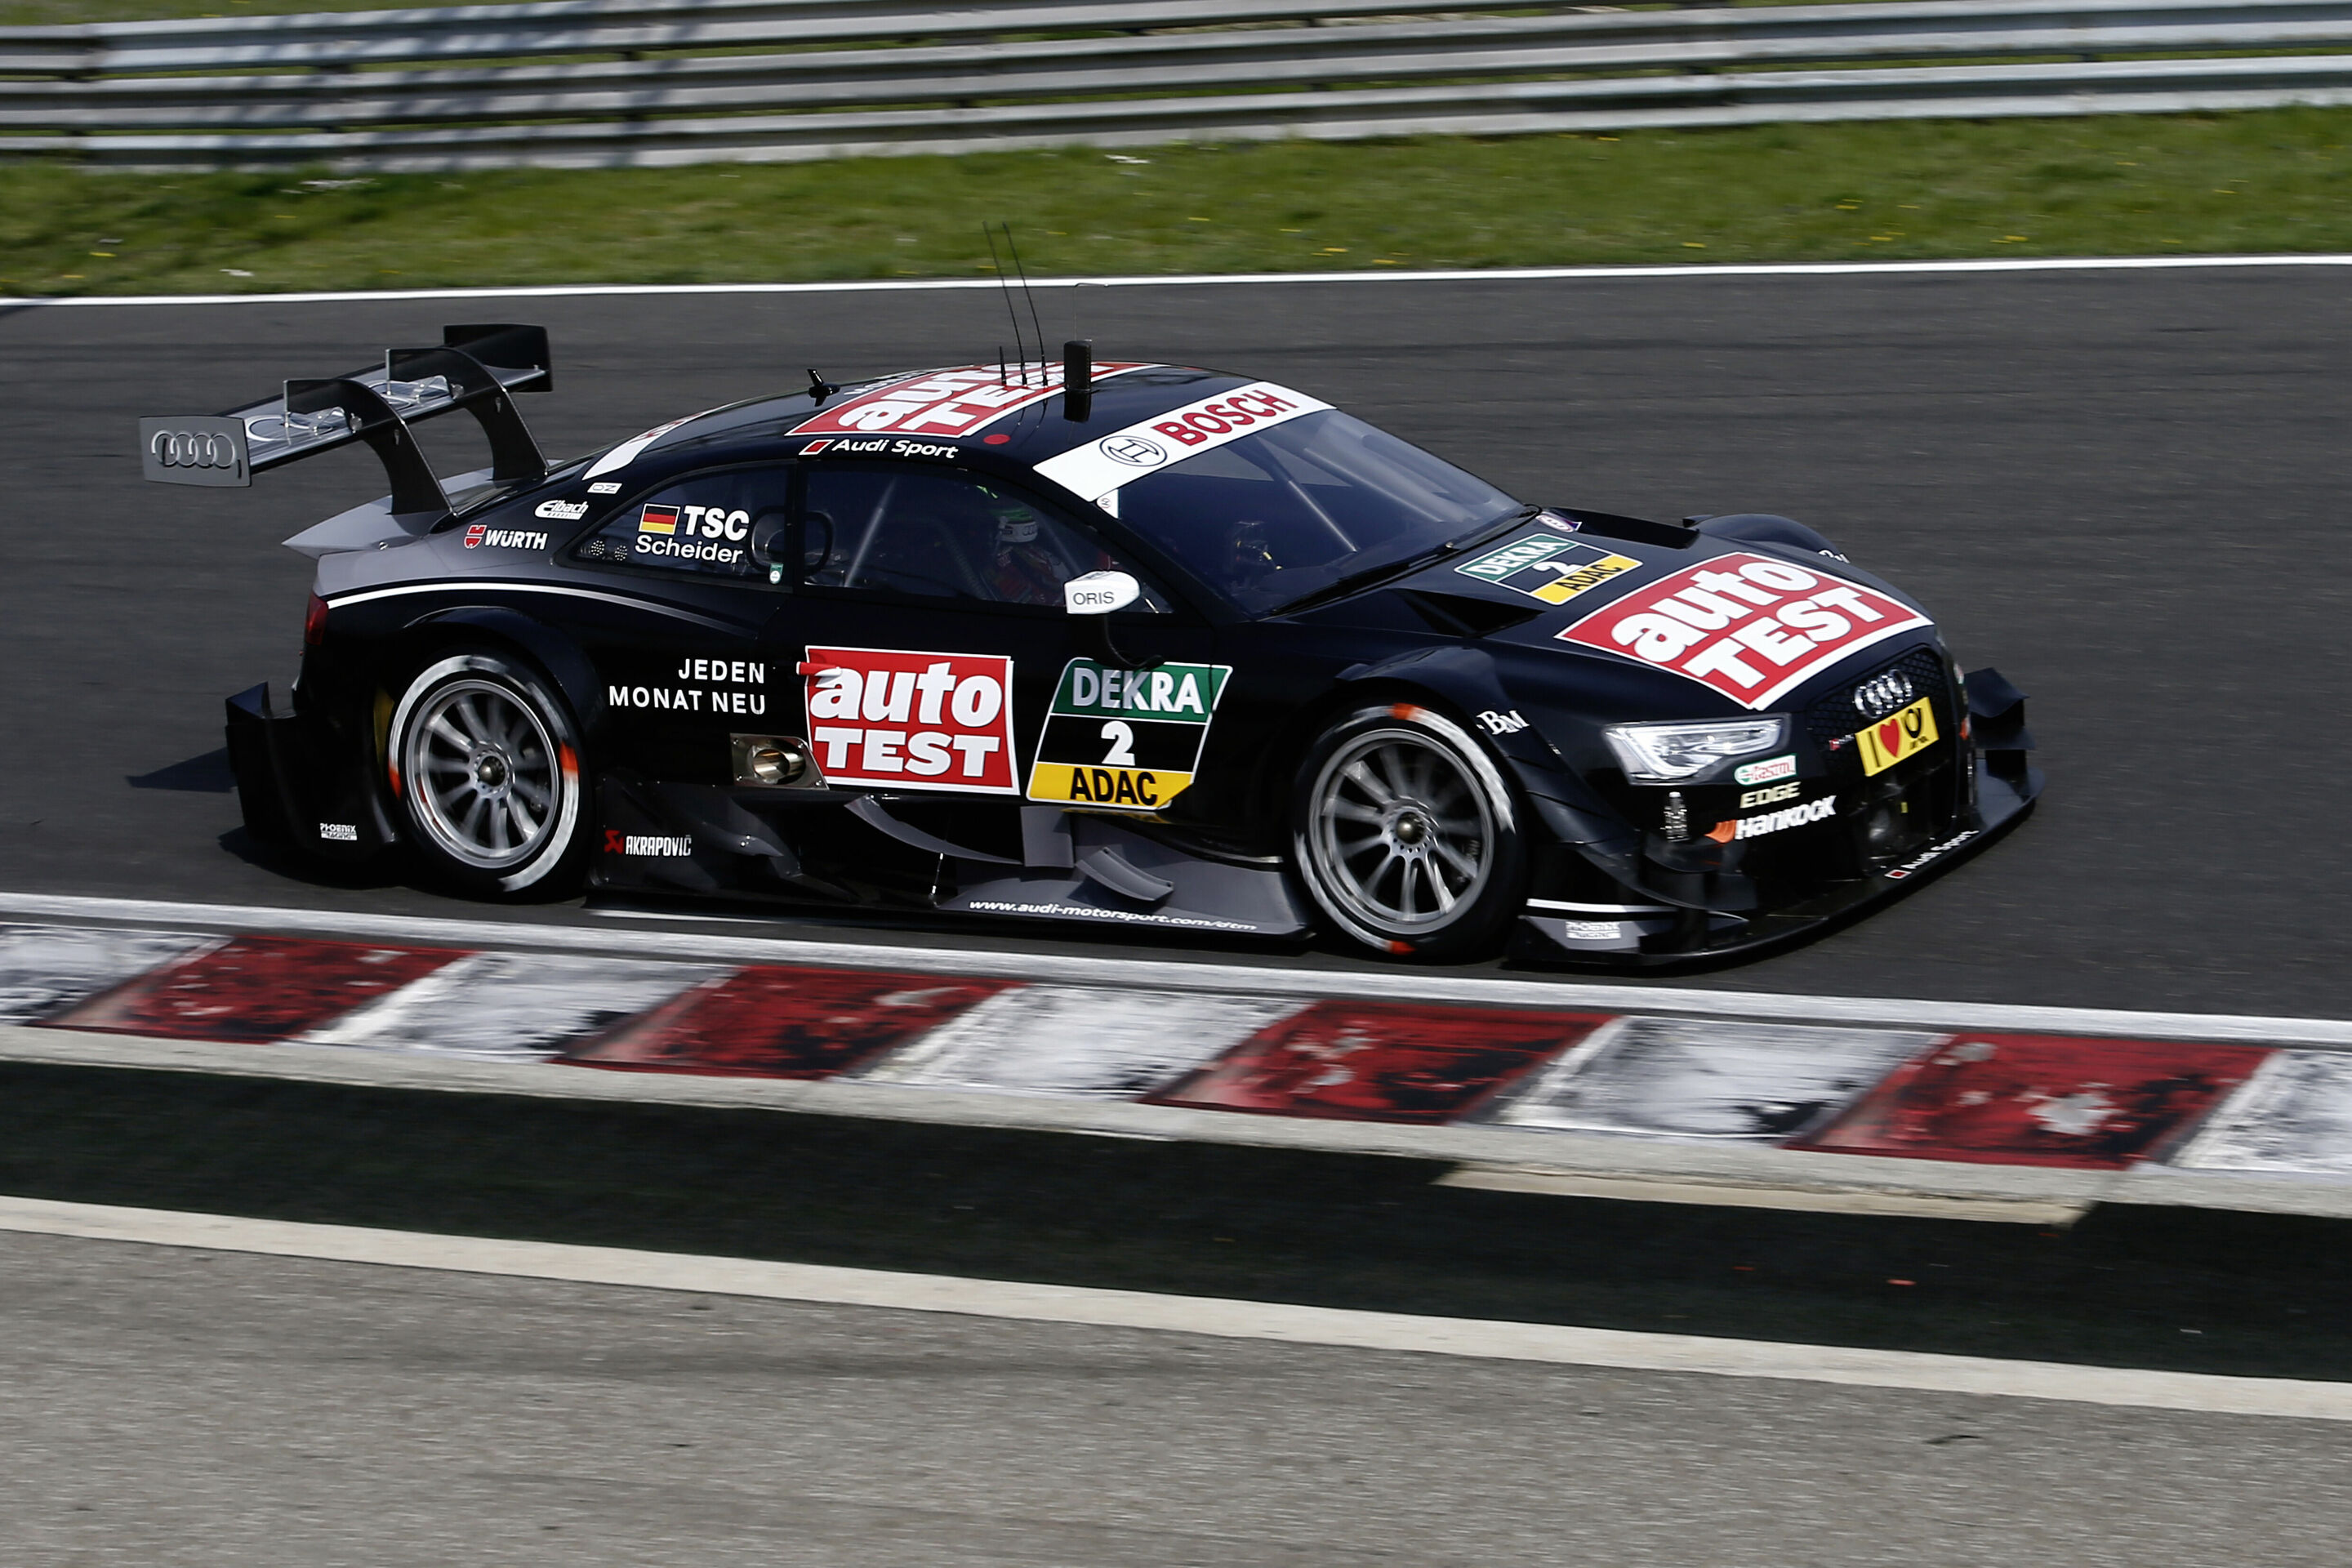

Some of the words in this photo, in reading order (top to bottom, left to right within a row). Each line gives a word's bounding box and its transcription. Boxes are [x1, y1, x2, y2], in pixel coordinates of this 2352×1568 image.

[838, 362, 1057, 430] auto
[1150, 390, 1299, 446] BOSCH
[831, 439, 889, 452] Audi
[891, 440, 959, 459] Sport
[535, 500, 589, 516] Eibach
[683, 506, 749, 541] TSC
[485, 529, 548, 550] WÜRTH
[635, 535, 743, 564] Scheider
[1466, 541, 1570, 575] DEKRA
[1532, 561, 1584, 575] 2
[1554, 564, 1623, 590] ADAC
[1073, 592, 1115, 605] ORIS
[1610, 562, 1819, 663] auto
[1681, 586, 1885, 689] TEST
[678, 658, 765, 684] JEDEN
[608, 685, 702, 711] MONAT
[712, 692, 766, 715] NEU
[809, 662, 1003, 727] auto
[1072, 667, 1205, 715] DEKRA
[814, 726, 1000, 777] TEST
[1100, 719, 1135, 766] 2
[1070, 768, 1158, 806] ADAC
[1740, 782, 1802, 808] EDGE
[969, 900, 1258, 931] www.audi-motorsport.com/dtm
